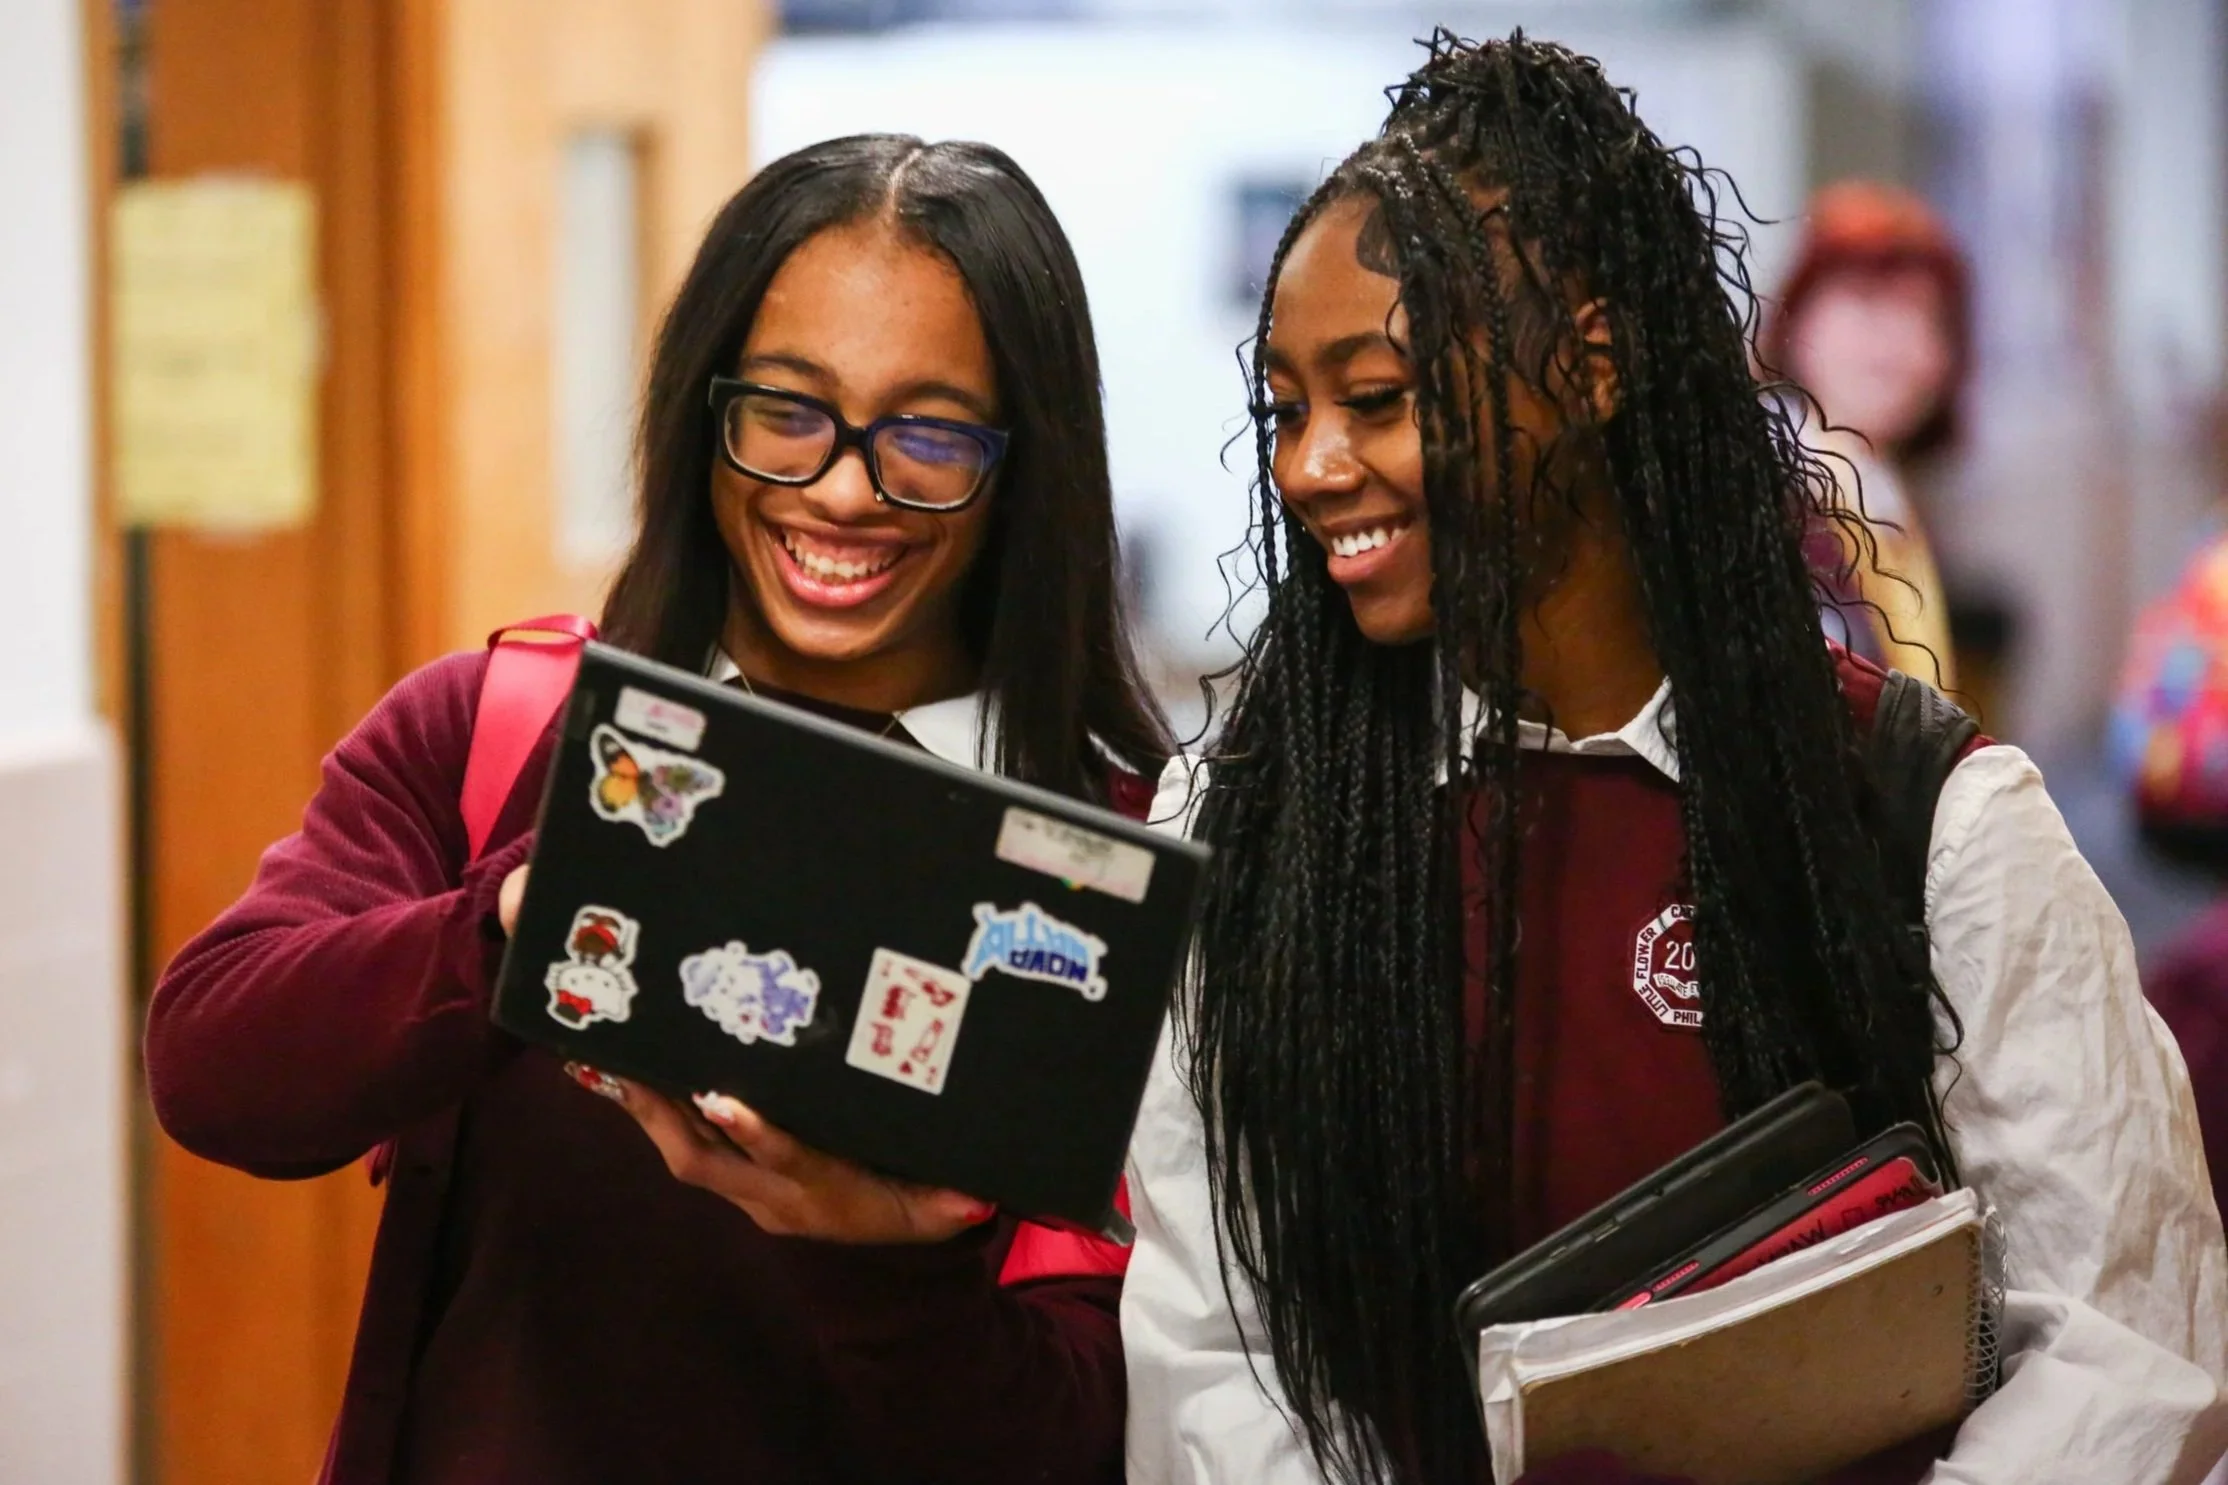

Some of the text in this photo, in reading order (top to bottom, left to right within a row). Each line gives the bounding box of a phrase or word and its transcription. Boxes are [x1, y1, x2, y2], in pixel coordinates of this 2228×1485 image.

[1636, 927, 1668, 1017] LITTLE FLOWER
[1665, 941, 1695, 970] 20
